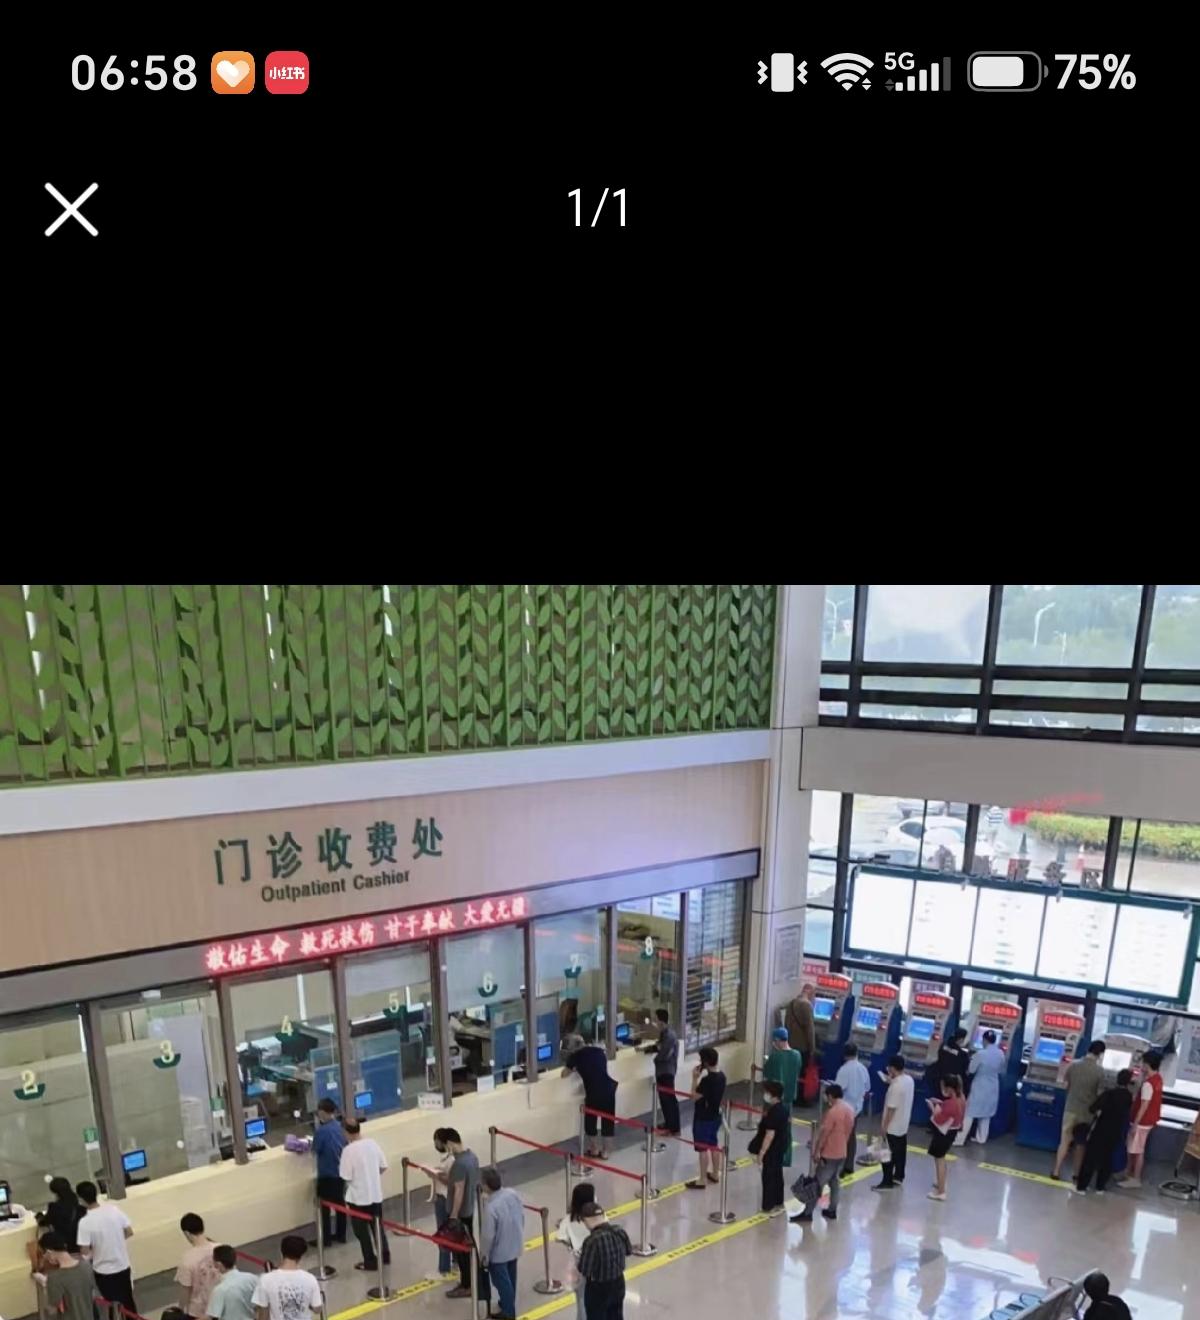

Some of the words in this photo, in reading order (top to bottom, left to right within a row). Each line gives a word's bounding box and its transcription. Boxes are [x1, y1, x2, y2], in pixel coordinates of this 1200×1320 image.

[213, 816, 444, 885] 门诊收费处
[261, 878, 347, 902] Outpatient
[353, 869, 410, 890] Cashier
[299, 920, 375, 955] 救死扶伤
[384, 907, 456, 941] 甘于奉献
[644, 935, 654, 956] 8
[482, 971, 494, 993] 6
[388, 991, 400, 1013] 5
[279, 1015, 293, 1037] 4
[160, 1039, 175, 1063] 3
[21, 1069, 39, 1095] 2
